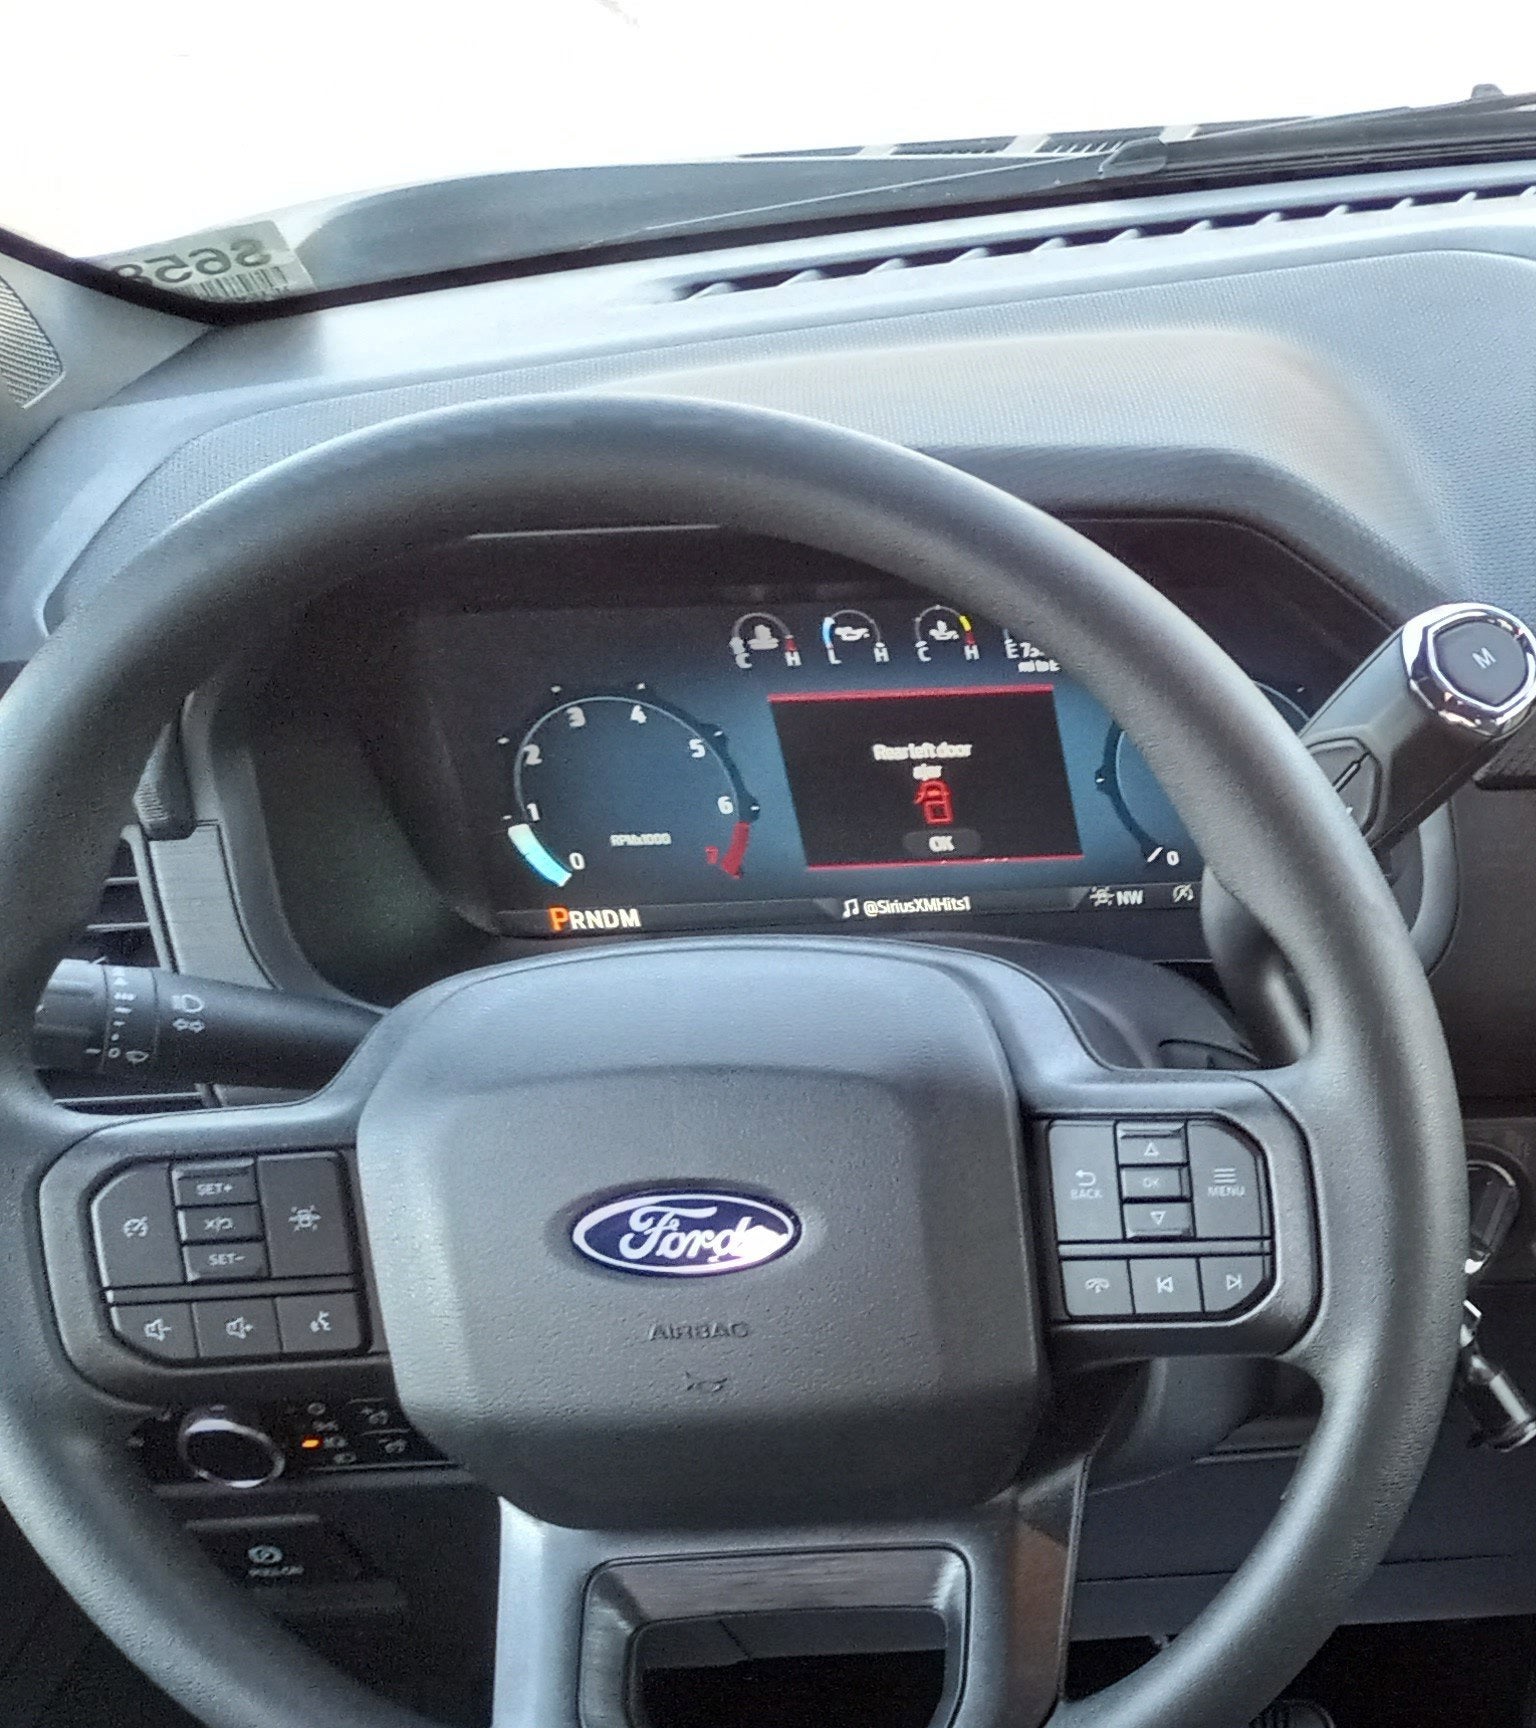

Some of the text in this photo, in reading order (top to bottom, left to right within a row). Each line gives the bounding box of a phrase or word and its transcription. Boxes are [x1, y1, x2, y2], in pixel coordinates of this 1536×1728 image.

[1472, 647, 1497, 668] M
[566, 706, 585, 727] 3
[630, 705, 647, 724] 4
[523, 744, 542, 765] 2
[689, 739, 705, 758] 5
[527, 803, 540, 821] 1
[717, 796, 733, 814] 6
[929, 836, 955, 852] OK
[569, 852, 585, 870] 0
[1167, 851, 1180, 866] 0
[1116, 890, 1144, 906] NW
[1143, 1178, 1160, 1188] OK
[1208, 1186, 1246, 1198] MENU
[1071, 1189, 1102, 1199] BACK
[619, 1206, 768, 1263] Ford
[650, 1322, 749, 1341] AIRBAG
